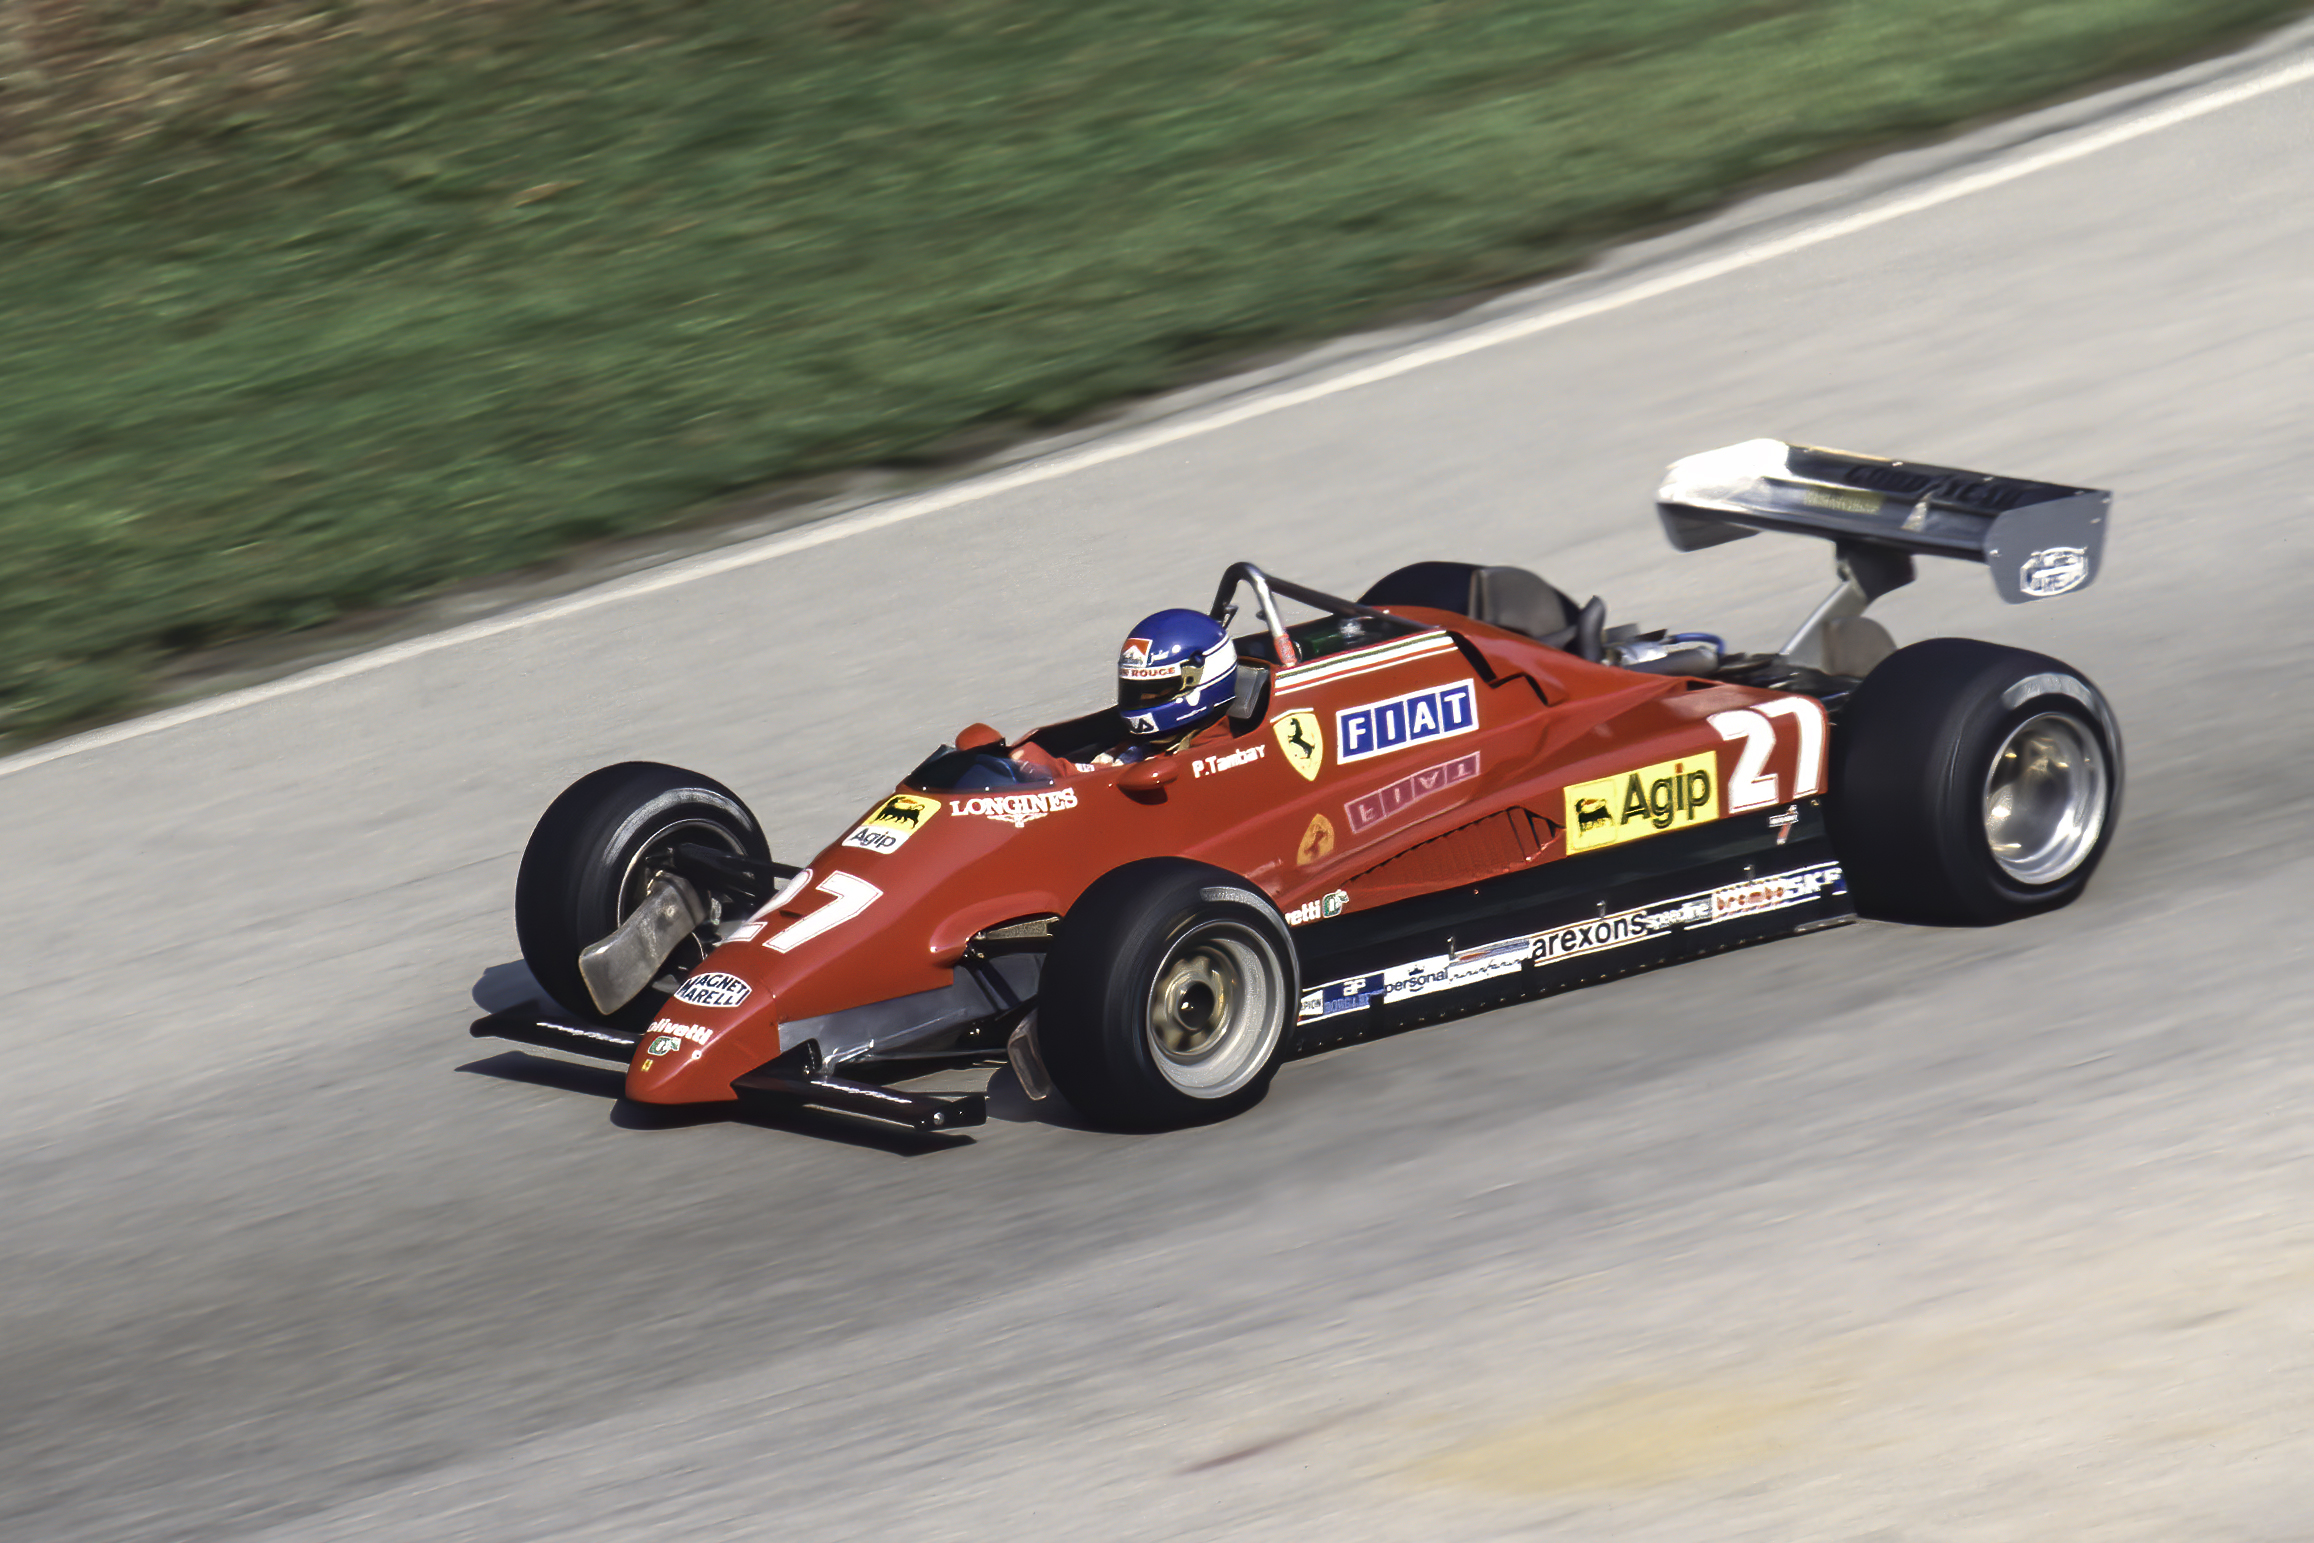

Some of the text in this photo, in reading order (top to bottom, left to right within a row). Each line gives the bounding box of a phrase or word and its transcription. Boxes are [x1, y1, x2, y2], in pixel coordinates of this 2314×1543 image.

[1131, 666, 1176, 677] ROUGE
[1347, 692, 1466, 750] FIAT
[1706, 695, 1826, 814] 27
[949, 787, 1078, 817] LONGINES
[1620, 762, 1711, 829] Agip
[850, 827, 897, 849] Agip
[1533, 912, 1647, 959] arexons
[676, 973, 750, 996] MAGNETI
[676, 984, 749, 1006] MARELLI
[1384, 966, 1448, 996] personal
